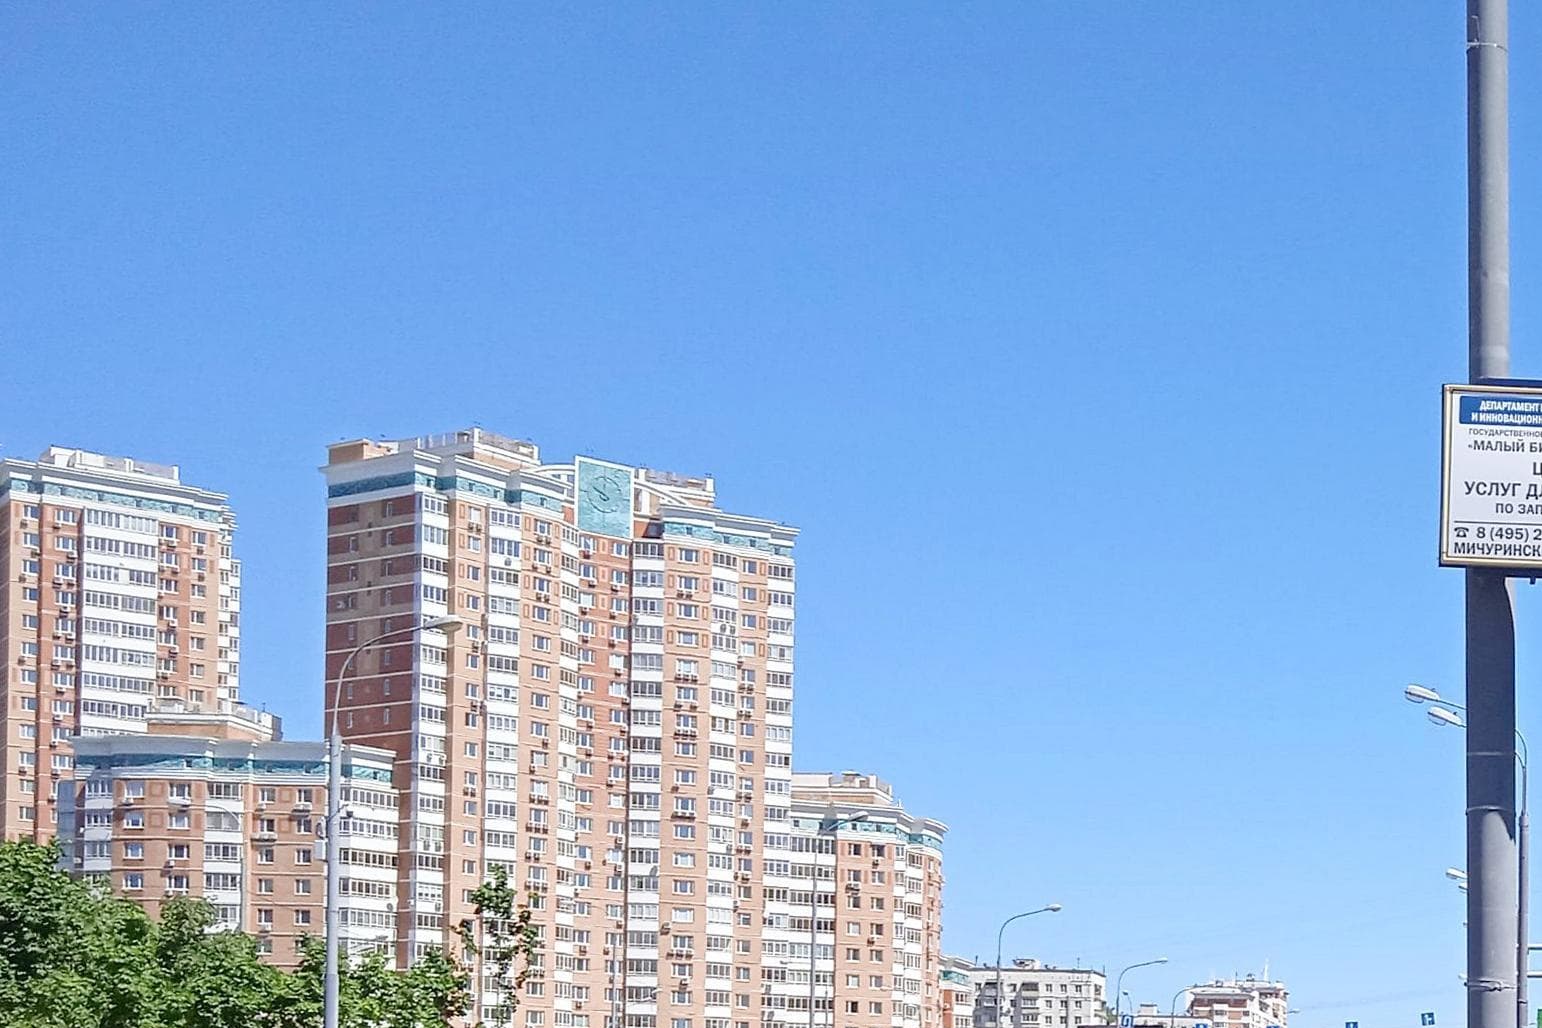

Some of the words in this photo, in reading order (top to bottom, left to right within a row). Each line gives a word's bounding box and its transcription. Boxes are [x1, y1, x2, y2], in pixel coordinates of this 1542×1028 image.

[1479, 400, 1540, 412] ДЕПАРТАМЕНТ
[1471, 411, 1478, 422] И
[1464, 480, 1522, 498] УСЛУГ
[1494, 502, 1514, 515] ПО
[1475, 526, 1486, 540] 8
[1489, 527, 1530, 543] (495)
